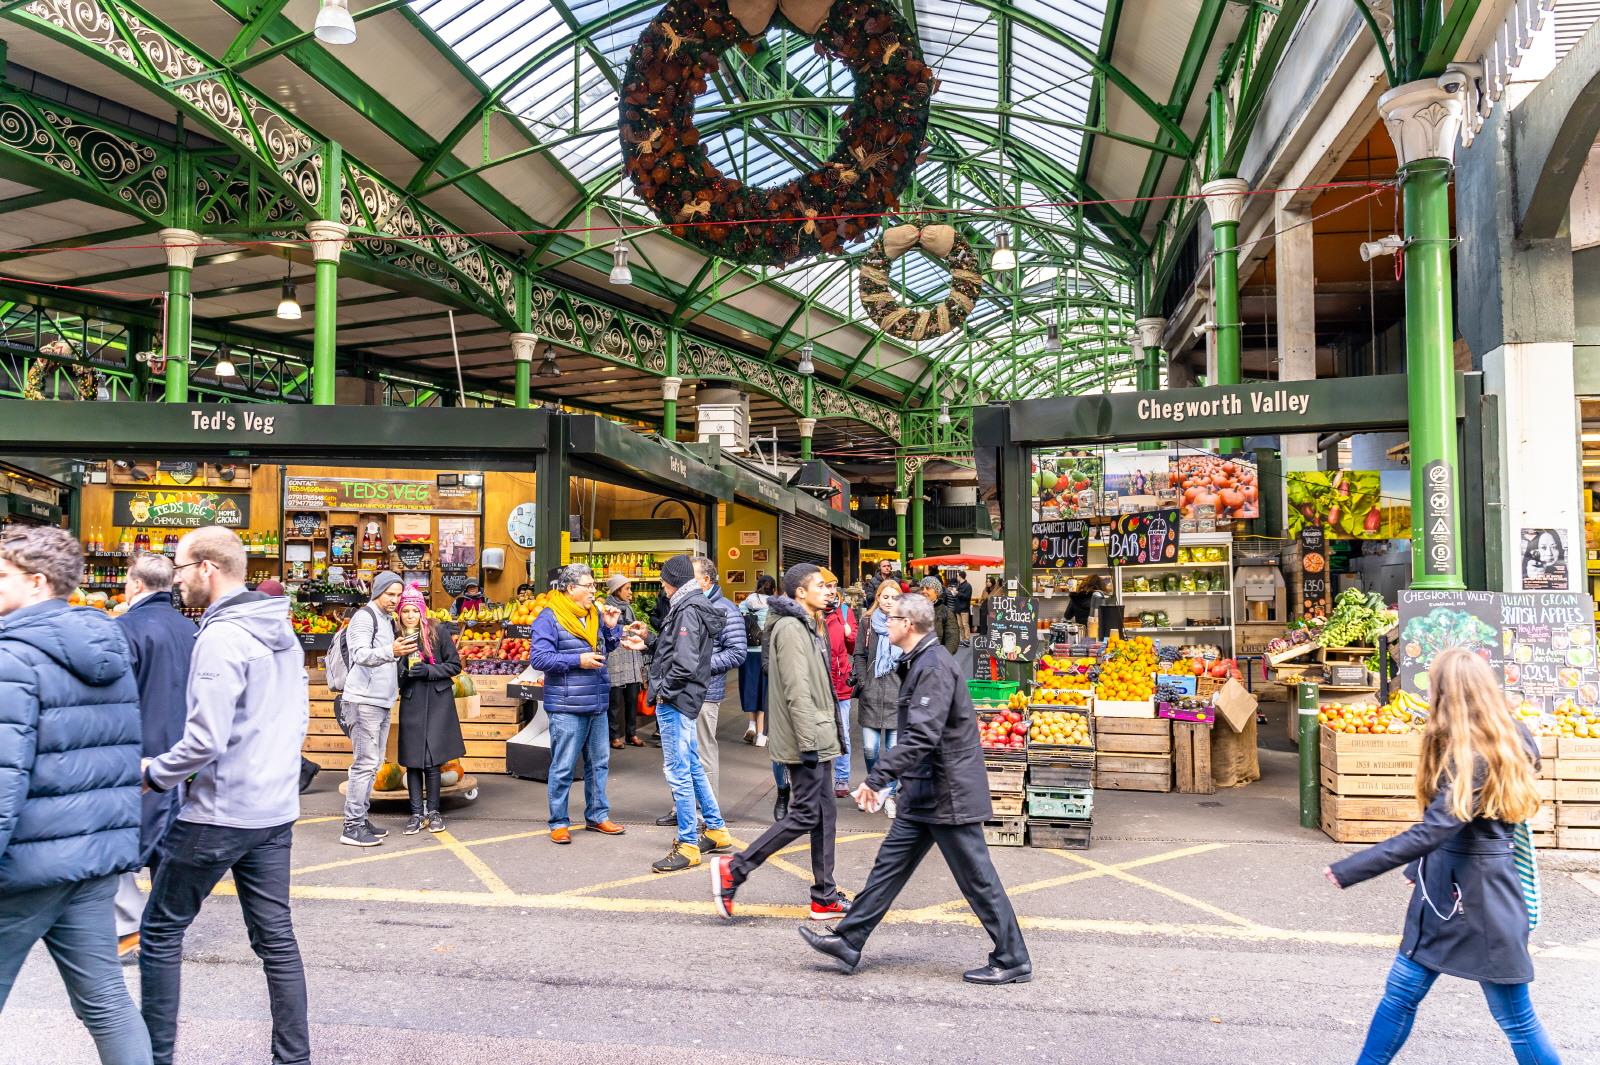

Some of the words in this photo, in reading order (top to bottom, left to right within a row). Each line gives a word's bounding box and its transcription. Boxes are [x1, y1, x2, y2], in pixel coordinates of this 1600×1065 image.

[1137, 393, 1242, 422] Chegworth
[1250, 390, 1310, 415] Valley
[191, 410, 236, 431] Ted's
[243, 411, 275, 435] Veg
[670, 455, 680, 473] Ted's
[340, 482, 390, 499] TEDS
[393, 484, 430, 501] VEG
[187, 504, 208, 516] VEG
[153, 517, 184, 526] CHEMICAL
[186, 517, 201, 526] FREE
[1047, 537, 1085, 560] JUICE
[1109, 533, 1140, 558] BAR
[1403, 591, 1463, 604] CHEGWORTH
[1466, 591, 1495, 605] VALLEY
[1540, 594, 1579, 606] GROWN
[1005, 611, 1031, 623] JUICE
[1540, 606, 1585, 624] APPLES
